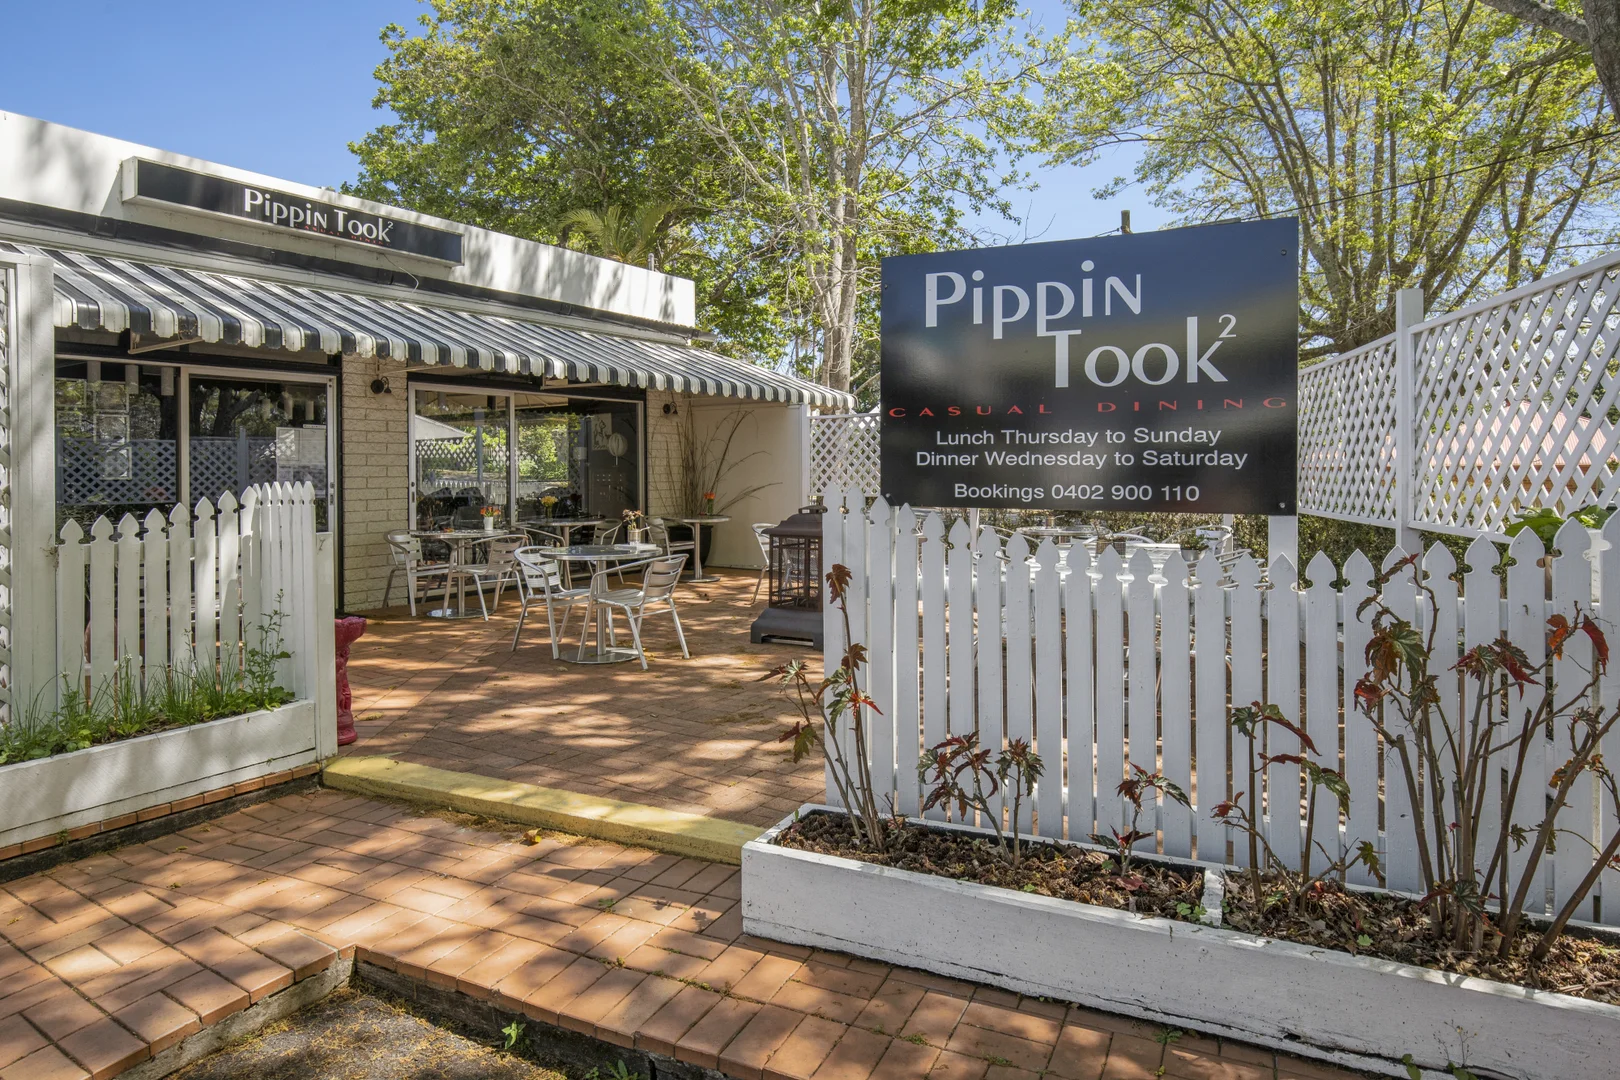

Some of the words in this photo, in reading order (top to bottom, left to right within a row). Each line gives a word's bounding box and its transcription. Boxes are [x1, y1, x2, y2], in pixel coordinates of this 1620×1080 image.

[889, 404, 1053, 418] CASUAL
[1097, 397, 1287, 413] DINING
[936, 430, 995, 446] Lunch
[1001, 429, 1099, 448] Thursday
[1105, 429, 1126, 444] to
[1133, 426, 1222, 447] Sunday
[916, 451, 980, 467] Dinner
[984, 450, 1108, 470] Wednesday
[1113, 451, 1135, 466] to
[1142, 450, 1248, 470] Saturday
[954, 483, 1045, 503] Bookings
[1051, 484, 1104, 501] 0402
[1111, 485, 1153, 501] 900
[1161, 485, 1200, 501] 110
